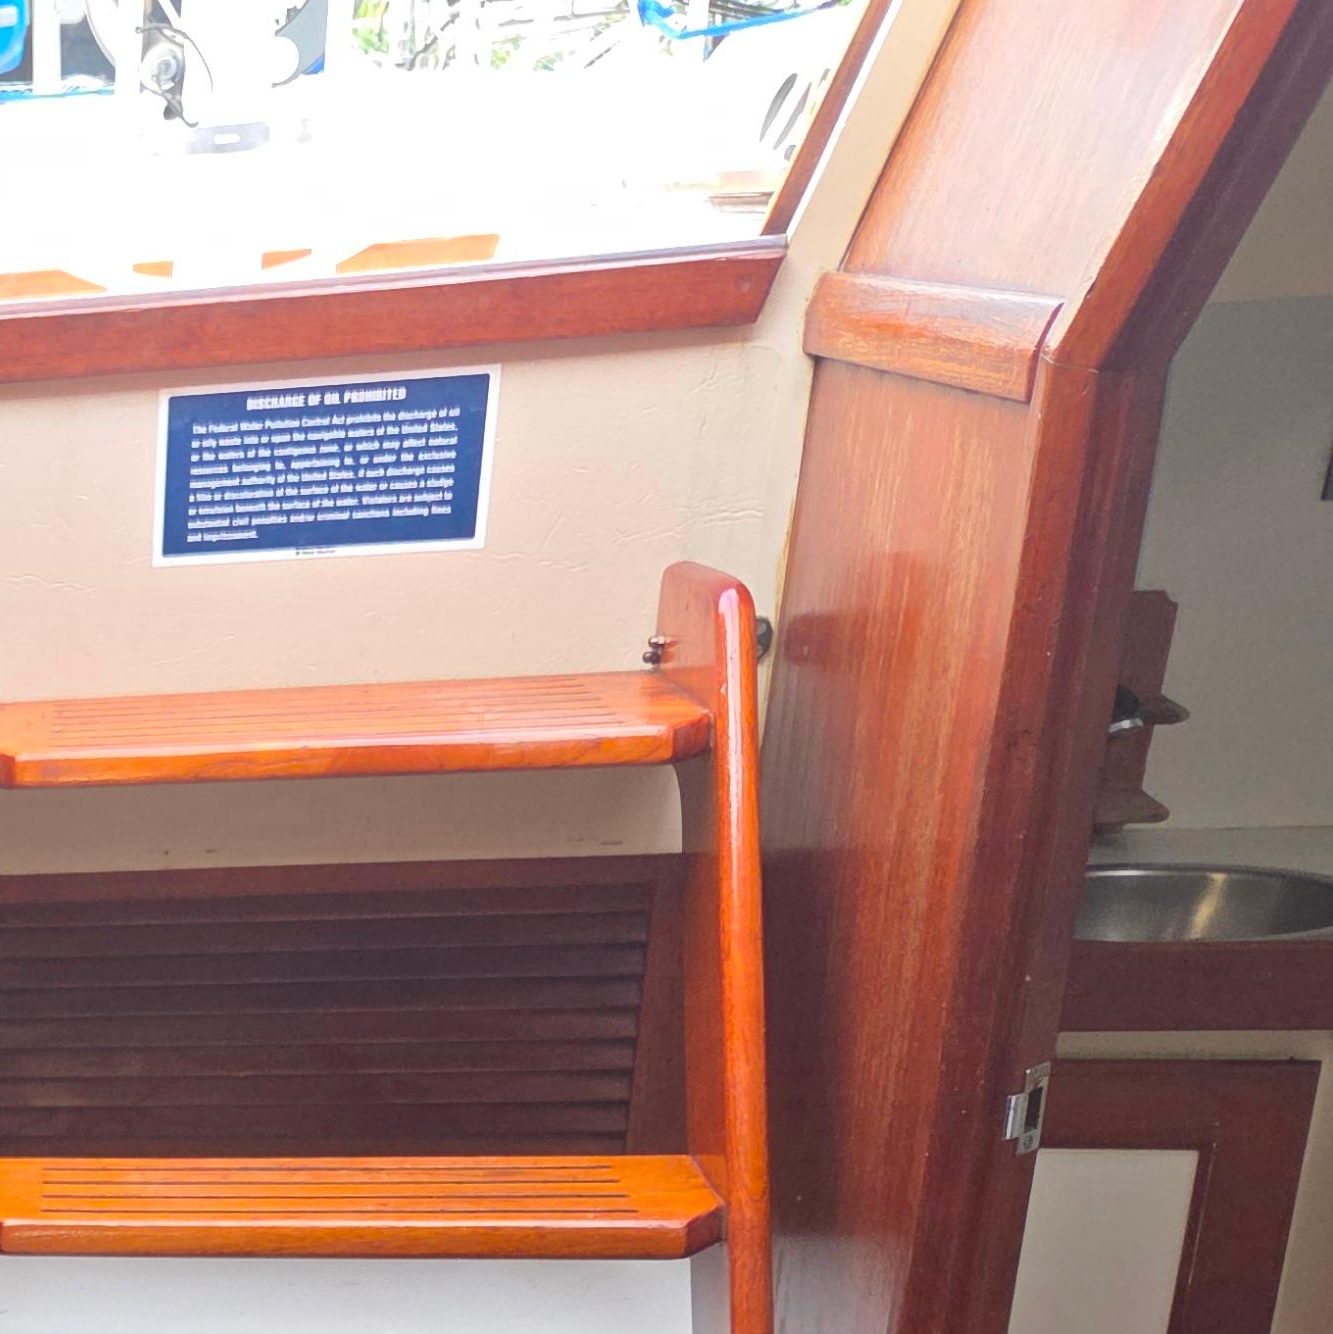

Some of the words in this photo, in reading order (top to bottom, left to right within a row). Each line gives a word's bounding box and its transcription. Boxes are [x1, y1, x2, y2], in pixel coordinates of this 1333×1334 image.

[246, 394, 305, 410] DISCHARGE
[307, 393, 321, 406] OF
[323, 391, 340, 404] OIL
[343, 386, 406, 403] PROHIBITED
